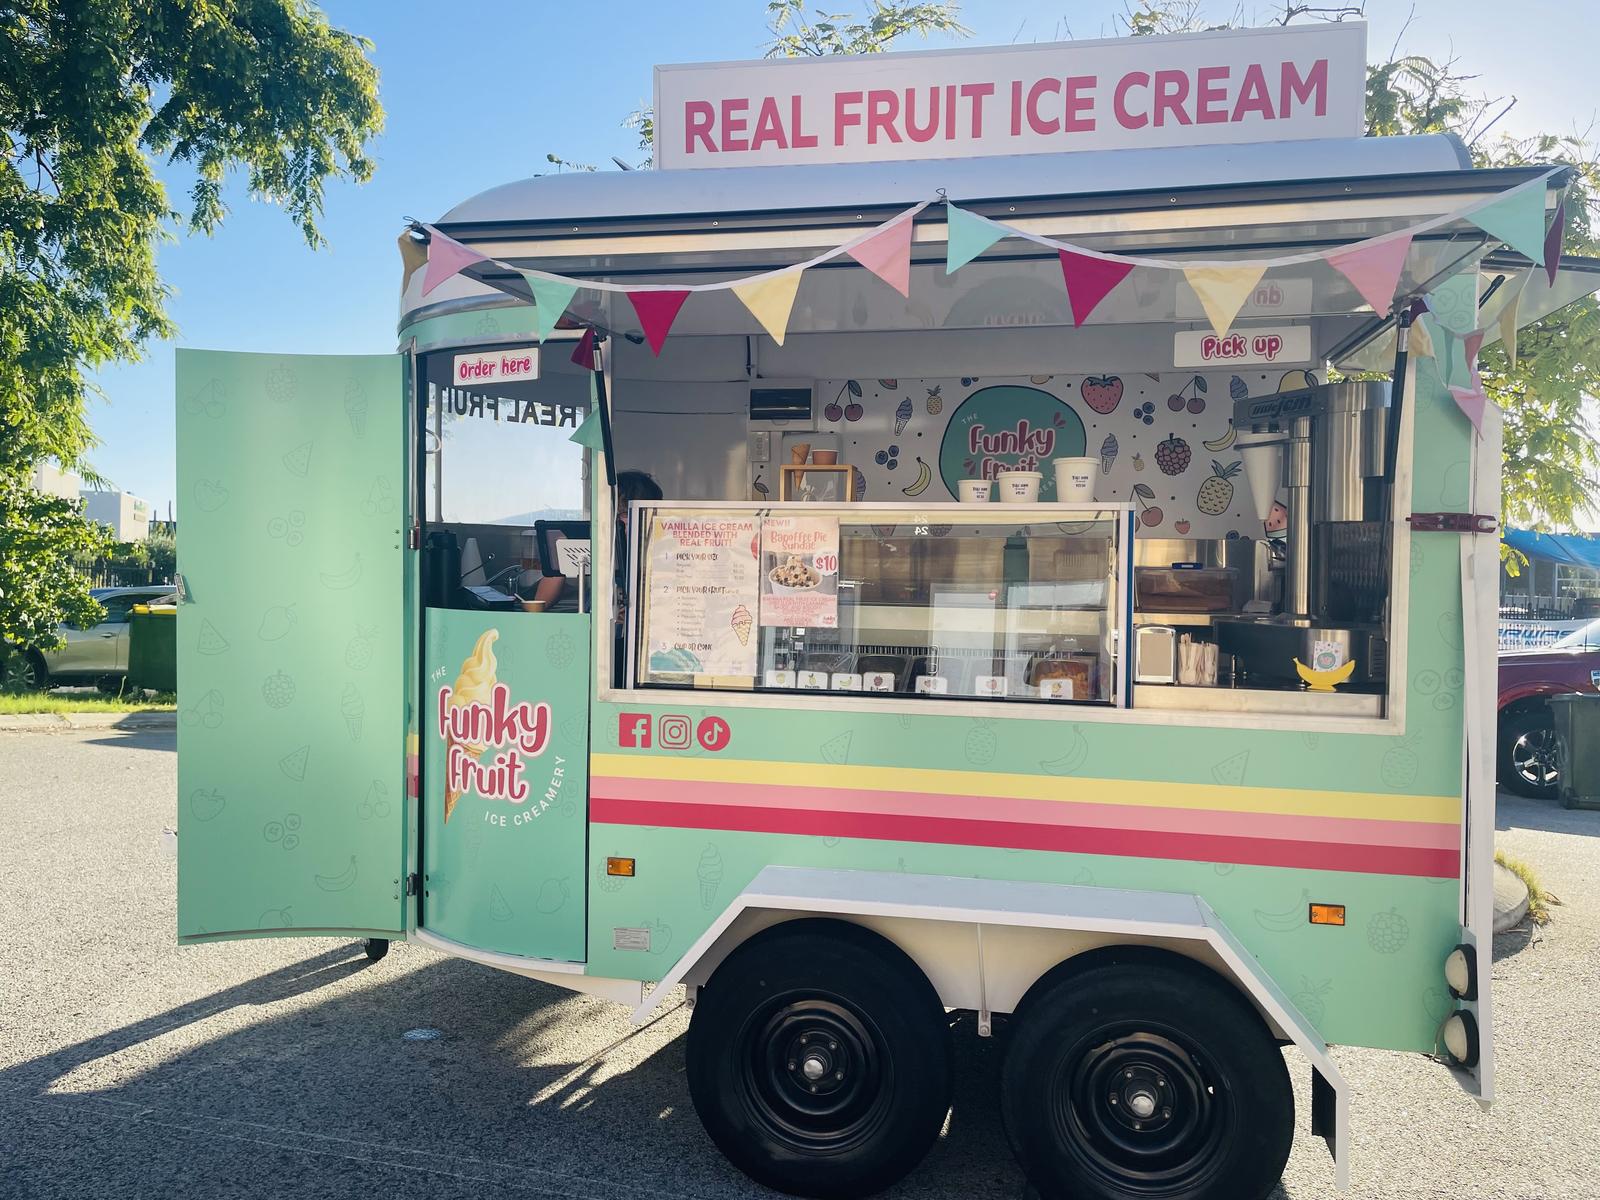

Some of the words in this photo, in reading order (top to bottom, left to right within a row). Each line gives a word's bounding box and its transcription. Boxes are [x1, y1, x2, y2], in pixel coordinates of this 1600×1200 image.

[685, 95, 819, 154] REAL
[834, 82, 995, 147] FRUIT
[1010, 75, 1097, 136] ICE
[1113, 58, 1329, 130] CREAM
[1201, 334, 1246, 359] Pick
[1252, 334, 1283, 361] up
[459, 358, 497, 381] Order
[500, 356, 531, 376] here
[961, 412, 979, 425] THE
[968, 419, 1056, 457] Funky
[661, 522, 699, 531] VANILLA
[701, 522, 717, 531] ICE
[719, 522, 753, 531] CREAM
[673, 531, 711, 539] BLENDED
[714, 531, 738, 539] WITH
[814, 530, 828, 543] Pie
[680, 539, 701, 547] REAL
[815, 555, 837, 571] $10
[431, 666, 447, 683] THE
[438, 683, 551, 757] Funky
[448, 743, 530, 803] Fruit
[484, 811, 508, 827] ICE
[512, 754, 567, 827] CREAMERY
